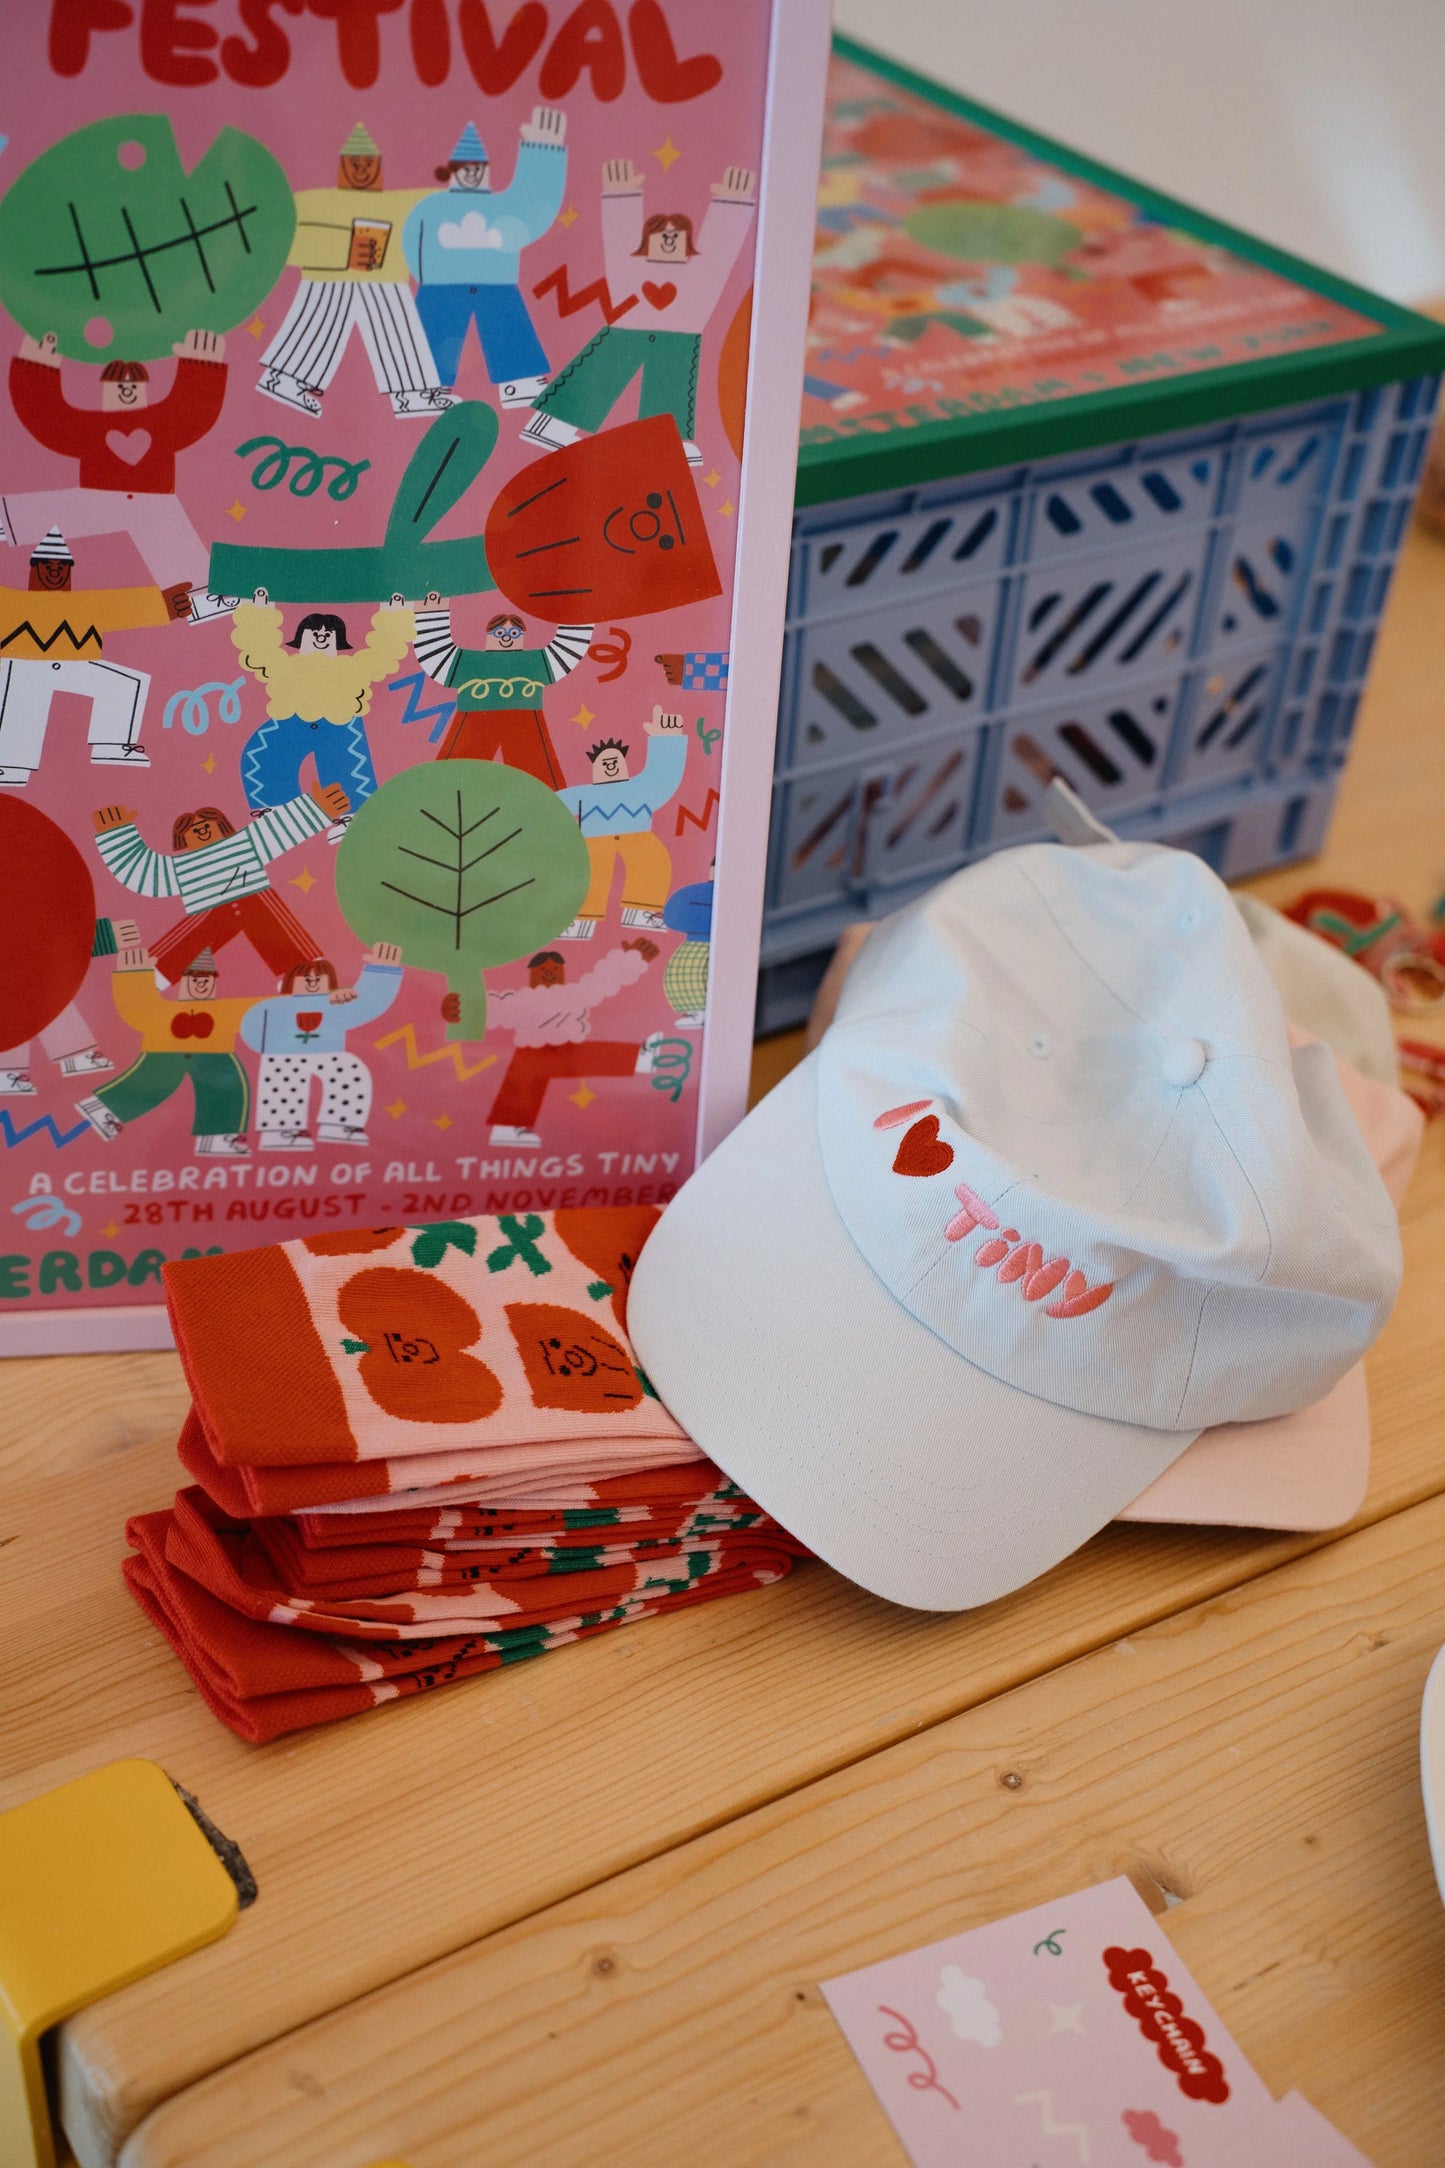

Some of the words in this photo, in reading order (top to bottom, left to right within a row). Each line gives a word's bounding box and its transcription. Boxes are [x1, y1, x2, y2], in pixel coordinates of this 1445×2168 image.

[47, 0, 724, 104] FESTIVAL
[29, 1172, 53, 1195] A
[63, 1163, 318, 1196] CELEBRATION
[330, 1162, 371, 1185] OF
[383, 1160, 442, 1184] ALL
[456, 1153, 585, 1180] THINGS
[597, 1151, 680, 1177] TINY
[123, 1201, 214, 1226] 28TH
[225, 1193, 366, 1222] AUGUST
[402, 1190, 474, 1215] 2ND
[485, 1181, 678, 1211] NOVEMBER
[0, 1245, 225, 1299] ERDA
[1126, 1969, 1208, 2076] KEYCHAIN
